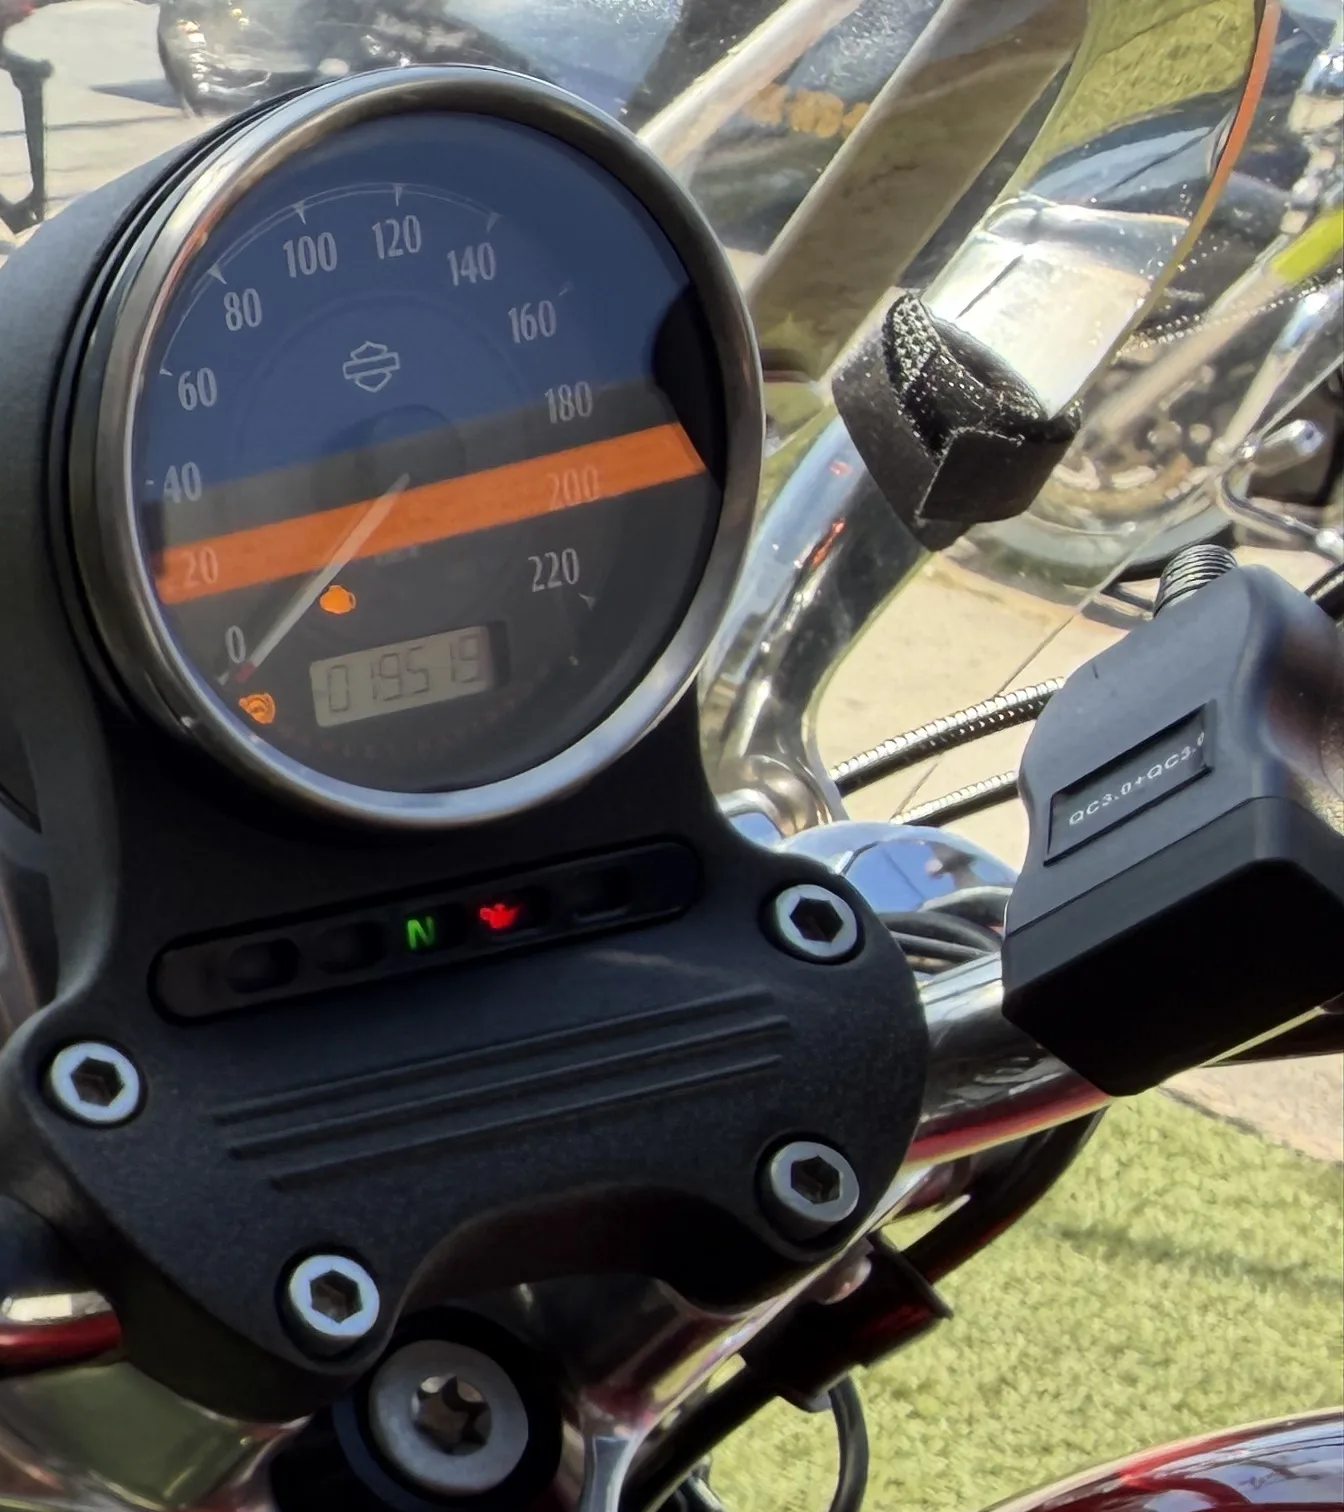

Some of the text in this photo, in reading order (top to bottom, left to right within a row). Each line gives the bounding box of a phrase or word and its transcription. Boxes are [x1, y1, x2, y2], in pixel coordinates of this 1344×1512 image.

[282, 232, 338, 278] 100
[372, 215, 422, 260] 120
[447, 242, 497, 286] 140
[223, 288, 262, 331] 80
[508, 300, 557, 343] 160
[178, 367, 218, 411] 60
[544, 381, 593, 424] 180
[163, 461, 202, 503] 40
[545, 464, 599, 511] 200
[181, 546, 219, 588] 20
[528, 548, 580, 592] 220
[224, 625, 247, 664] 0
[405, 916, 435, 950] N
